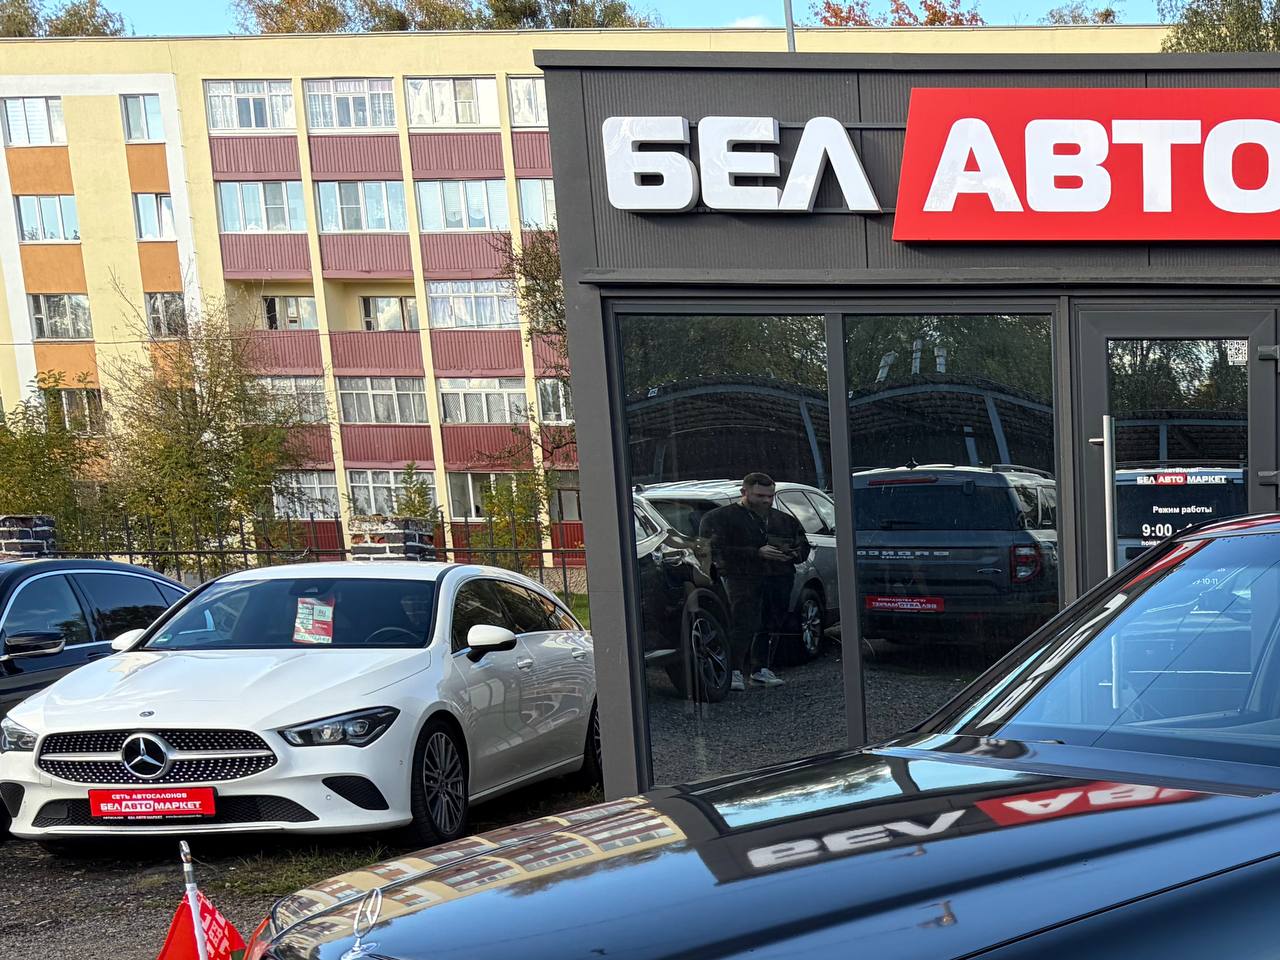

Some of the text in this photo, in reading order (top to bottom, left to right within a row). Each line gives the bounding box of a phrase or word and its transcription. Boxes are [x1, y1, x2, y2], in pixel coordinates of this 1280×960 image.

[602, 115, 881, 214] БЕЛ
[1136, 475, 1227, 485] БЕЛ АВТО МАРКЕТ
[1152, 505, 1212, 515] Режим работы
[1141, 523, 1173, 537] 9:00
[132, 792, 187, 800] АВТОСАЛОНОВ
[100, 801, 201, 811] БЕЛ АВТО МАРКЕТ
